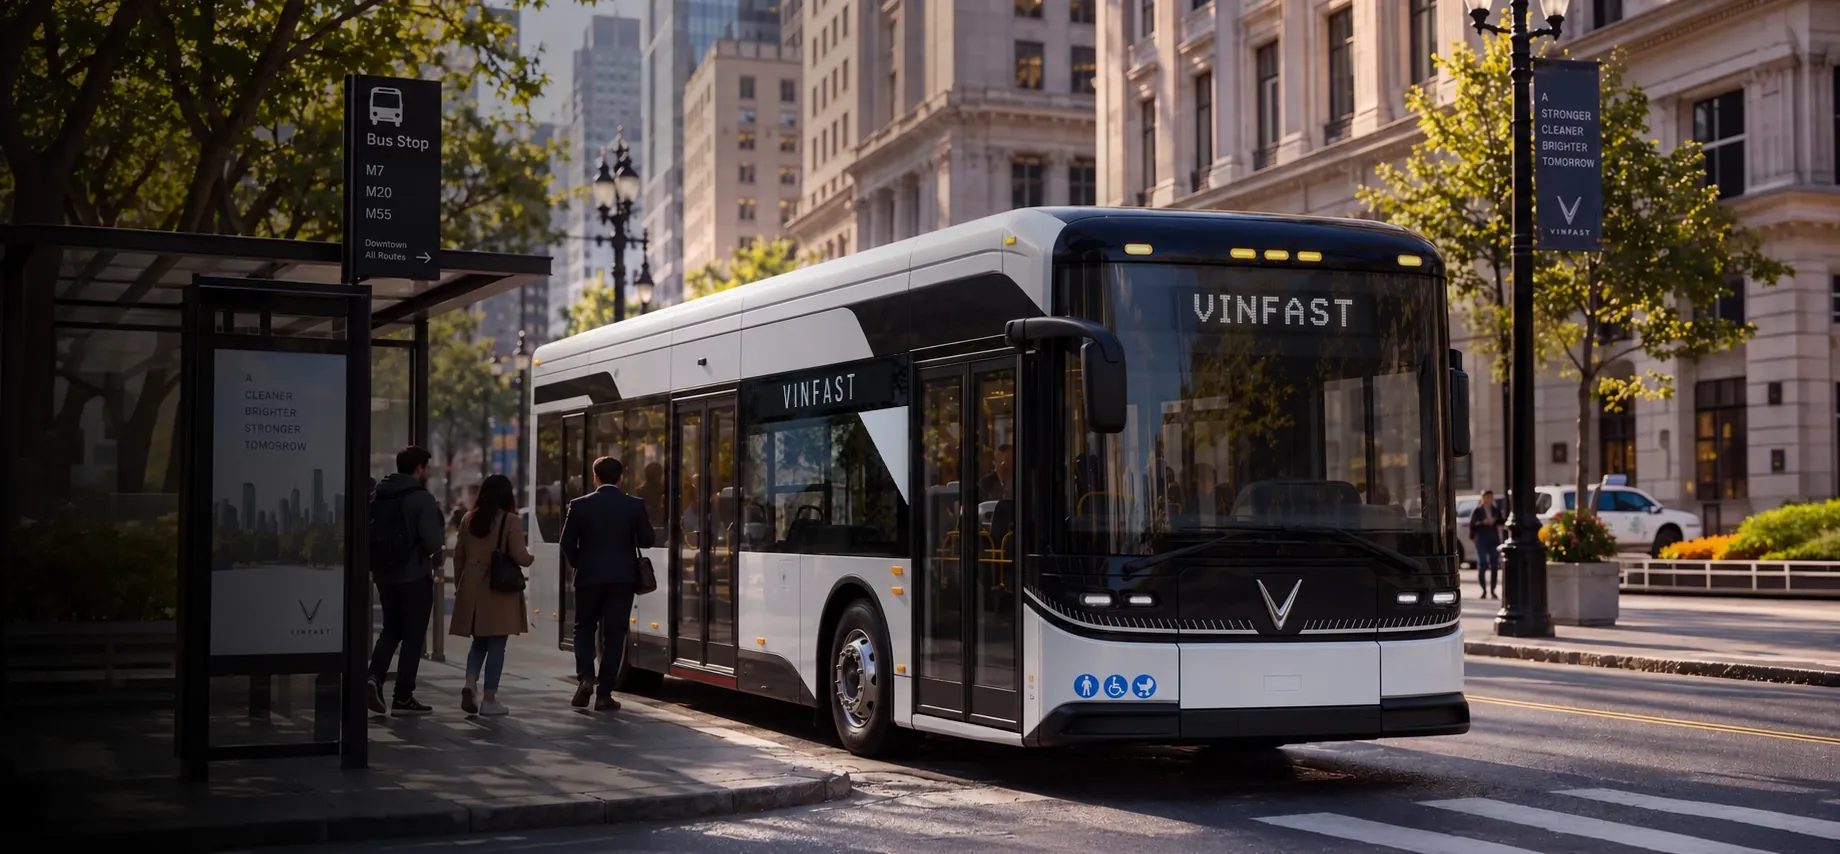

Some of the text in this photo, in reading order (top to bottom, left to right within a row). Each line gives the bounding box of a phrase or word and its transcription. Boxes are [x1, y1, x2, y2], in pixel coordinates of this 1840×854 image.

[1541, 92, 1549, 102] A
[1541, 109, 1592, 121] STRONGER
[1541, 124, 1584, 136] CLEANER
[366, 133, 429, 152] Bus Stop
[1542, 140, 1588, 153] BRIGHTER
[1542, 156, 1595, 168] TOMORROW
[366, 164, 384, 176] M7
[366, 186, 392, 198] M20
[366, 208, 392, 220] M55
[1549, 228, 1591, 236] VINFAST
[365, 239, 407, 249] Downtown
[365, 251, 407, 261] All Routes
[1193, 293, 1353, 327] VINFAST
[244, 373, 253, 383] A
[244, 390, 293, 401] CLEANER
[782, 373, 856, 409] VINFAST
[244, 406, 297, 418] BRIGHTER
[244, 422, 301, 434] STRONGER
[244, 440, 308, 451] TOMORROW
[290, 628, 330, 636] VINFAST
